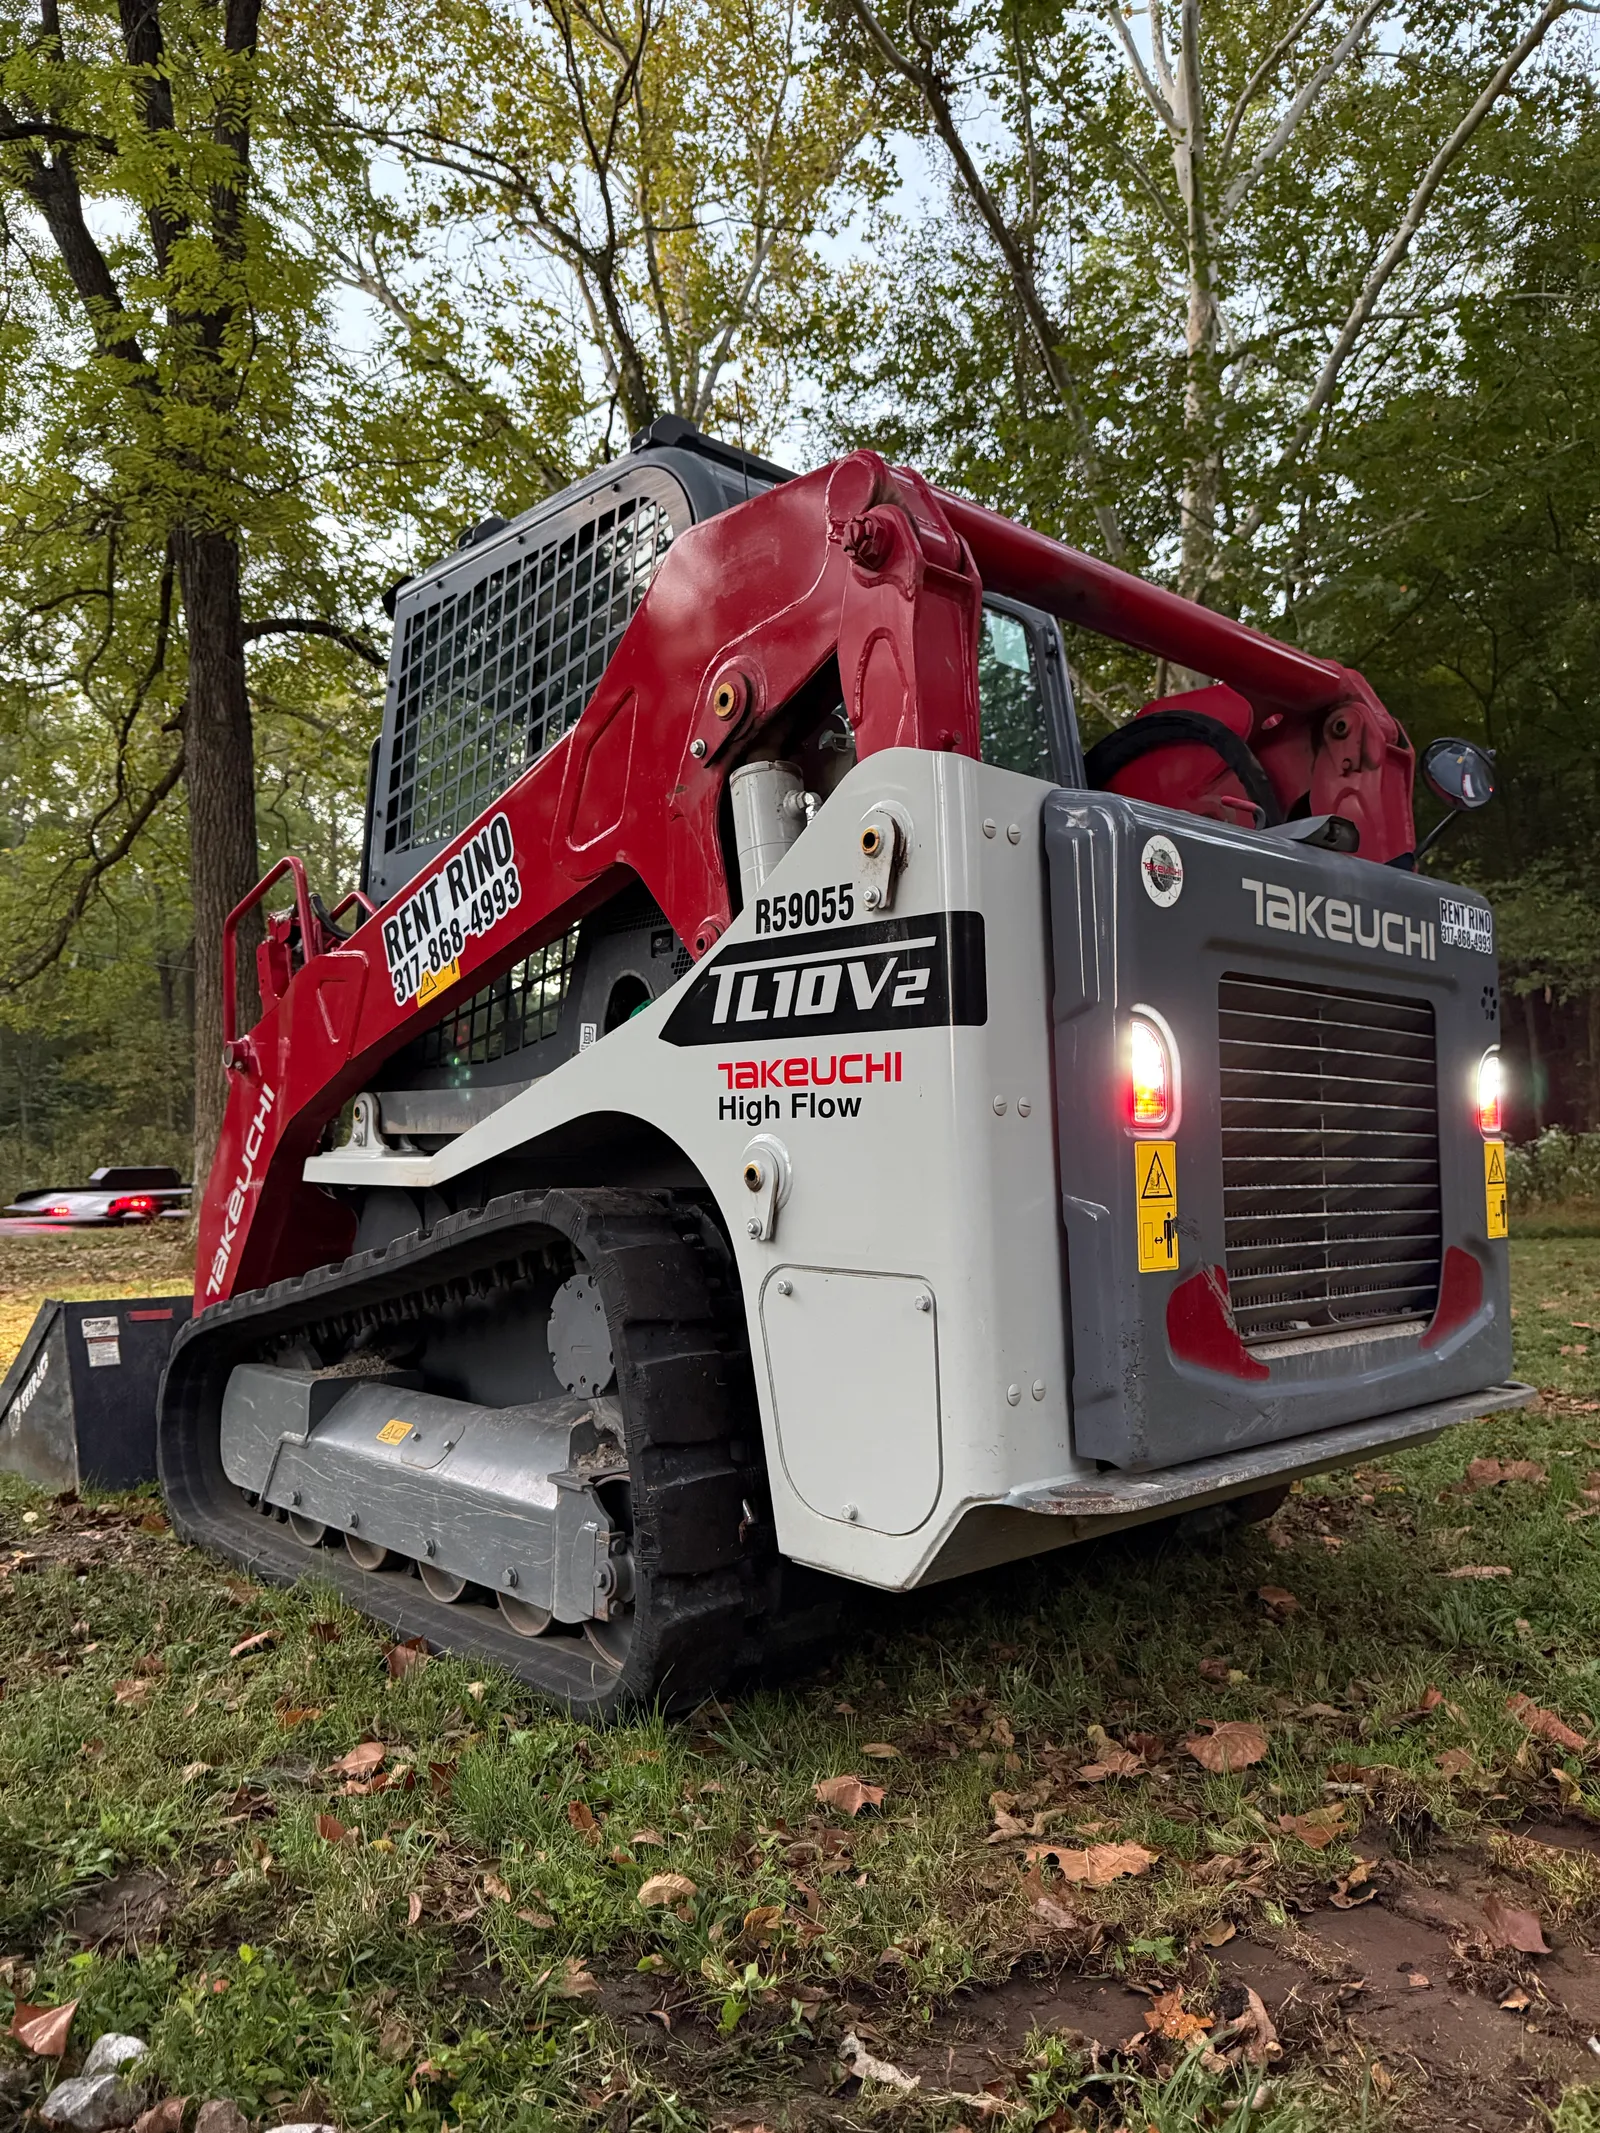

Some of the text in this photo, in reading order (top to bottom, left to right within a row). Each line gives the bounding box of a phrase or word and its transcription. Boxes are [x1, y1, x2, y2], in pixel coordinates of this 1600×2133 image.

[384, 815, 512, 969] RENT RINO
[755, 882, 854, 935] R59055
[1241, 877, 1436, 961] TAKEUCHI
[1440, 899, 1491, 934] RENT RINO
[393, 866, 520, 1002] 317-868-4993
[1441, 925, 1491, 953] 317-868-4993
[708, 935, 937, 1025] TL10V2
[717, 1051, 902, 1090] TAKEUCHI
[718, 1093, 862, 1126] High Flow
[205, 1083, 275, 1297] TAKEUCHI
